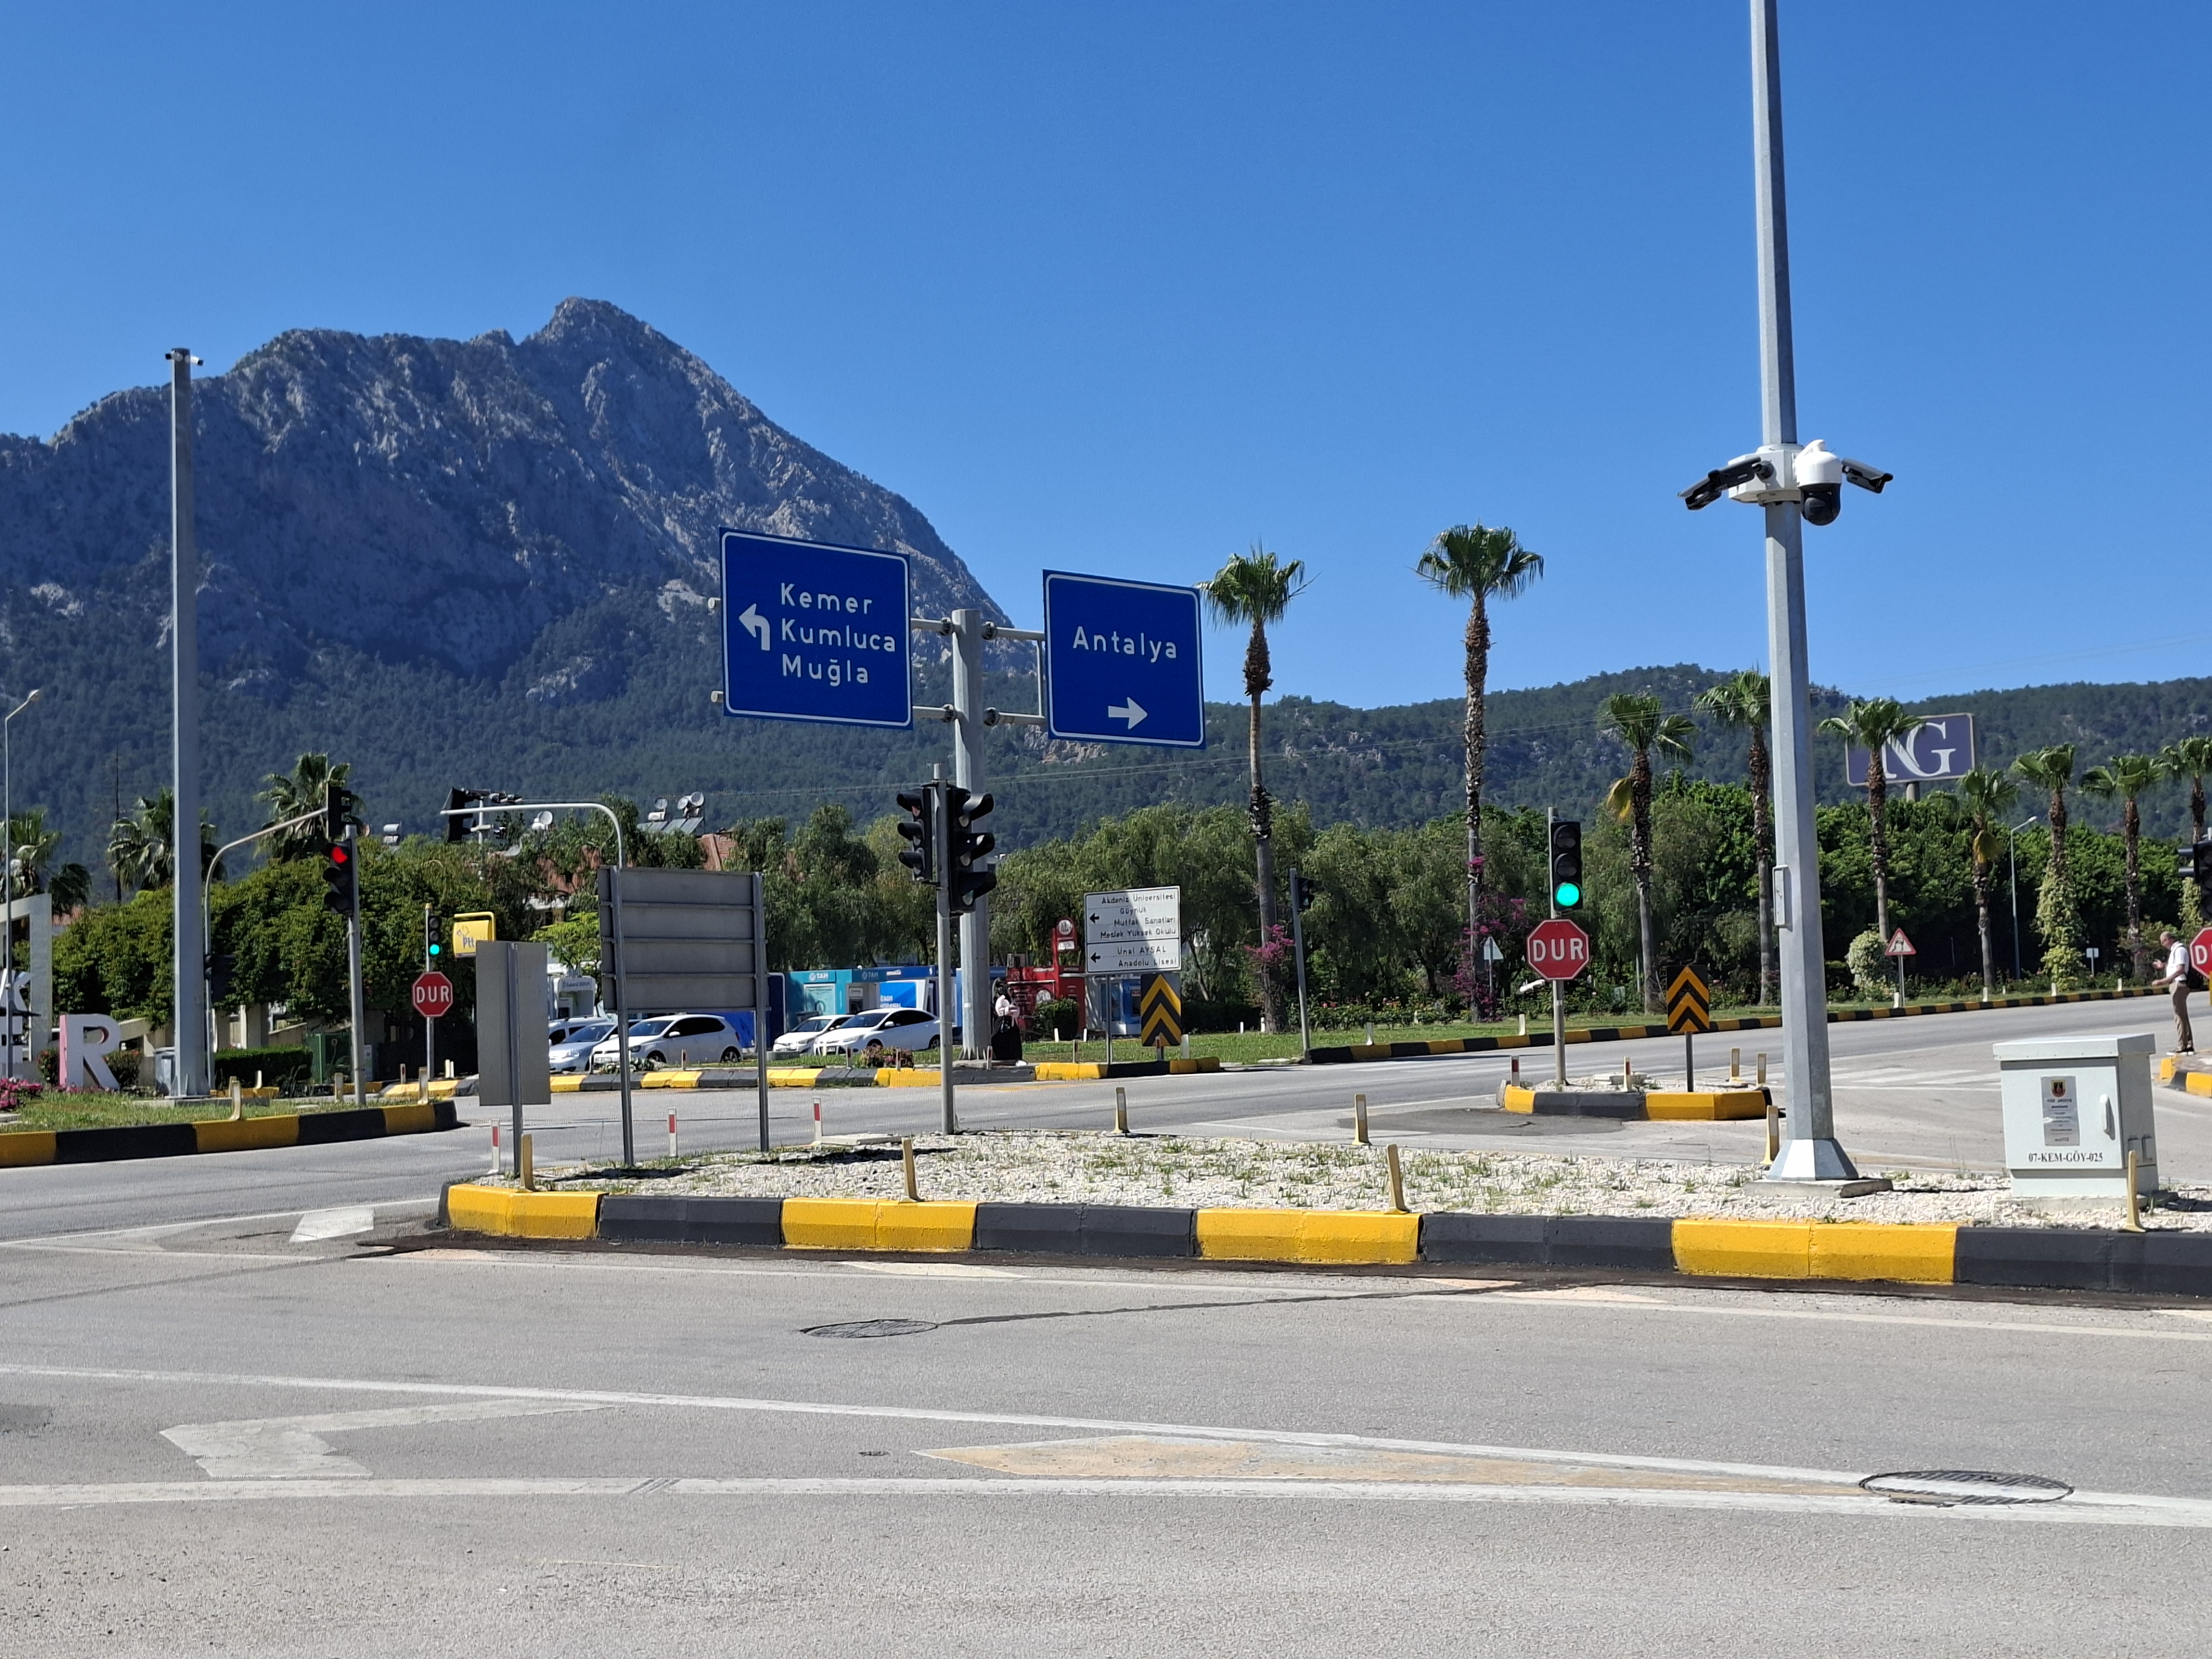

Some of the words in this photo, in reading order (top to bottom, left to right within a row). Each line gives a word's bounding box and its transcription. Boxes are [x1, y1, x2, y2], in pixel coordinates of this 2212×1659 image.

[781, 582, 873, 615] Kemer
[782, 618, 895, 653] Kumluca
[1073, 625, 1177, 664] Antalya
[782, 654, 869, 687] Muğla
[1156, 927, 1176, 936] Okulu
[1139, 945, 1166, 954] AYSAL
[1533, 938, 1584, 961] DUR
[2194, 943, 2212, 964] D
[1119, 959, 1149, 968] Anadolu
[416, 985, 449, 1003] DUR
